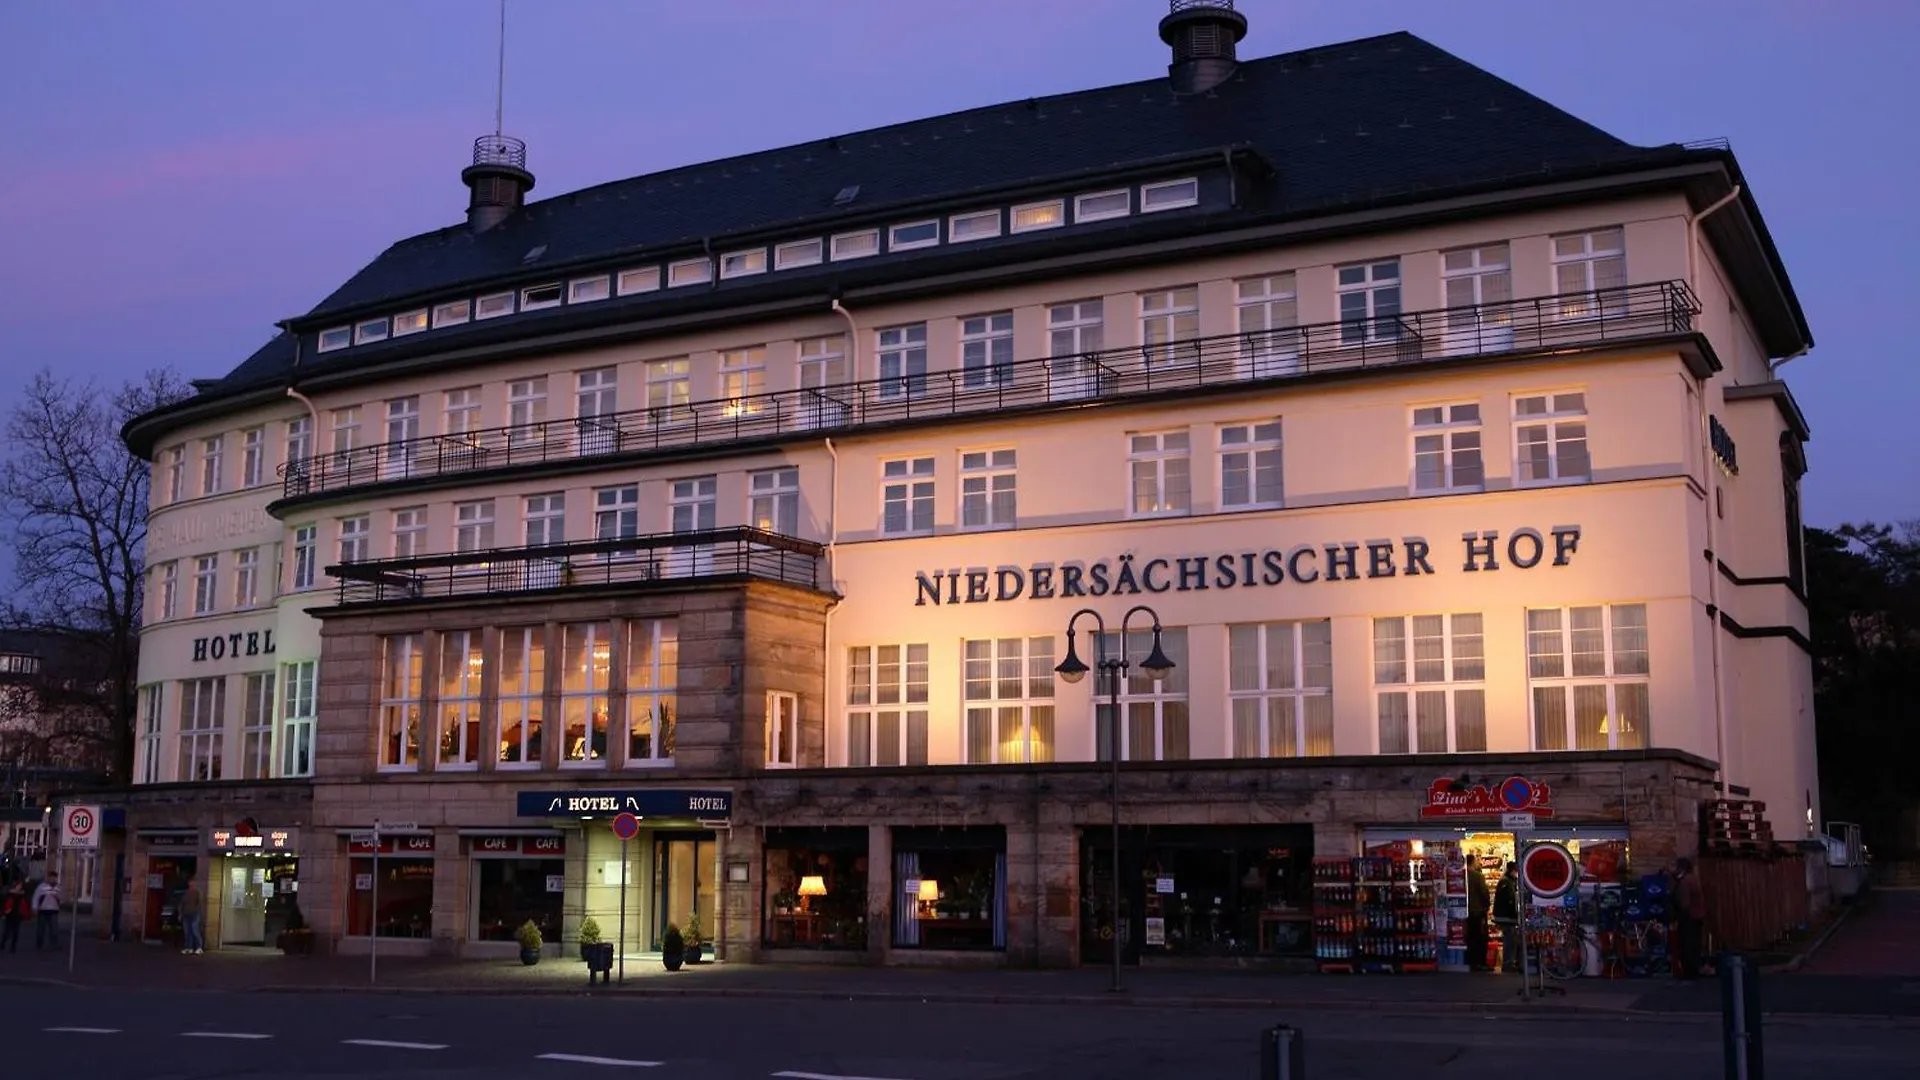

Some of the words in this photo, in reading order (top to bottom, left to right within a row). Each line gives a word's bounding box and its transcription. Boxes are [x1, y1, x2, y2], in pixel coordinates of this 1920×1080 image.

[915, 538, 1434, 606] NIEDERSÄCHSISCHER
[1462, 525, 1582, 572] HOF
[192, 630, 276, 662] HOTEL
[567, 797, 618, 812] HOTEL
[688, 797, 725, 811] HOTEL
[74, 815, 88, 828] 30
[69, 837, 90, 845] ZONE
